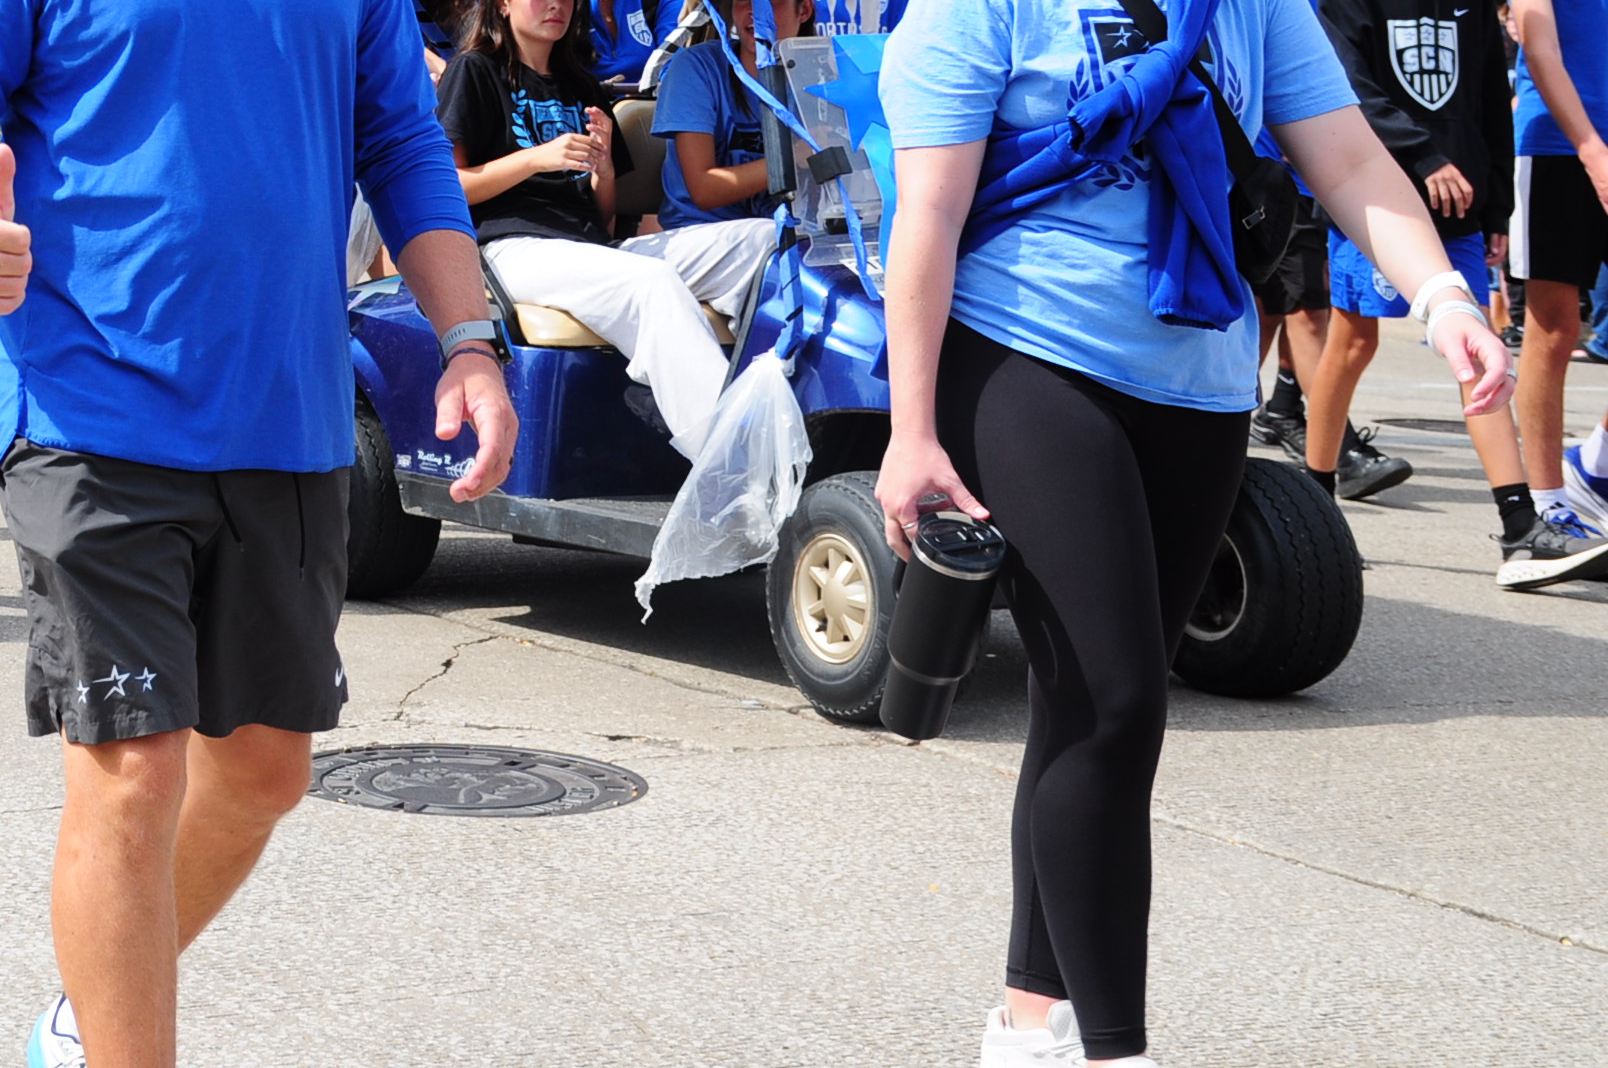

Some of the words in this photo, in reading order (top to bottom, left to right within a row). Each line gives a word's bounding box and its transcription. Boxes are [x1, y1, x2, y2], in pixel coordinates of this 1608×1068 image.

[1402, 46, 1454, 73] SCN
[417, 449, 443, 466] Rolling
[444, 453, 452, 466] R
